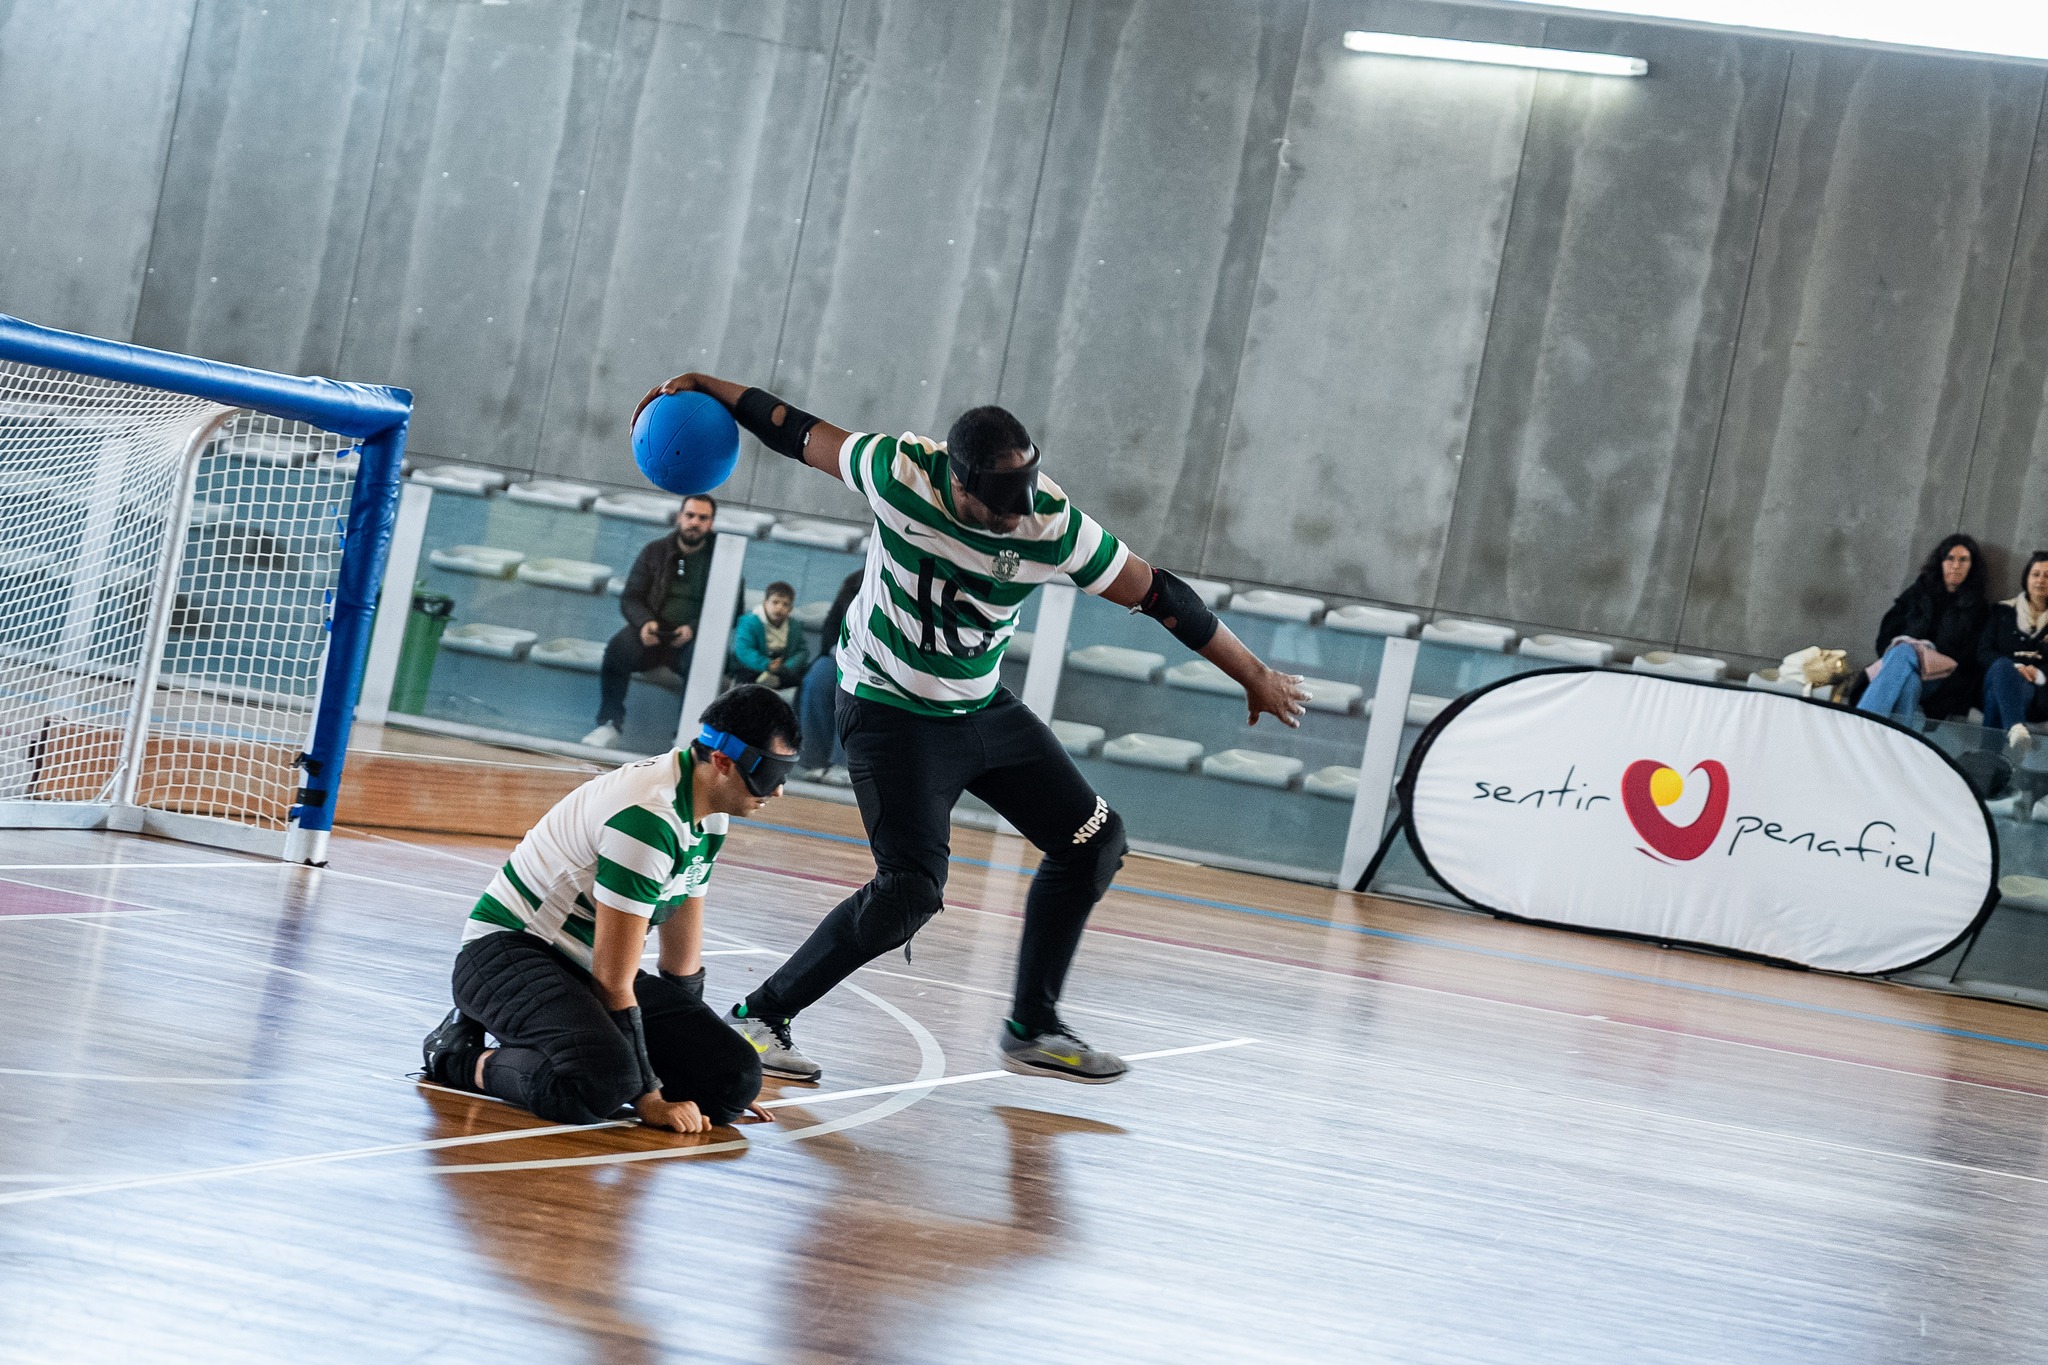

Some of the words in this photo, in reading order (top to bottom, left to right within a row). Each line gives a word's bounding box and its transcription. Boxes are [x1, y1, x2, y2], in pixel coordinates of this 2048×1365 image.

[918, 557, 995, 659] 16
[1473, 765, 1611, 810] sentir
[1728, 815, 1936, 877] penafiel
